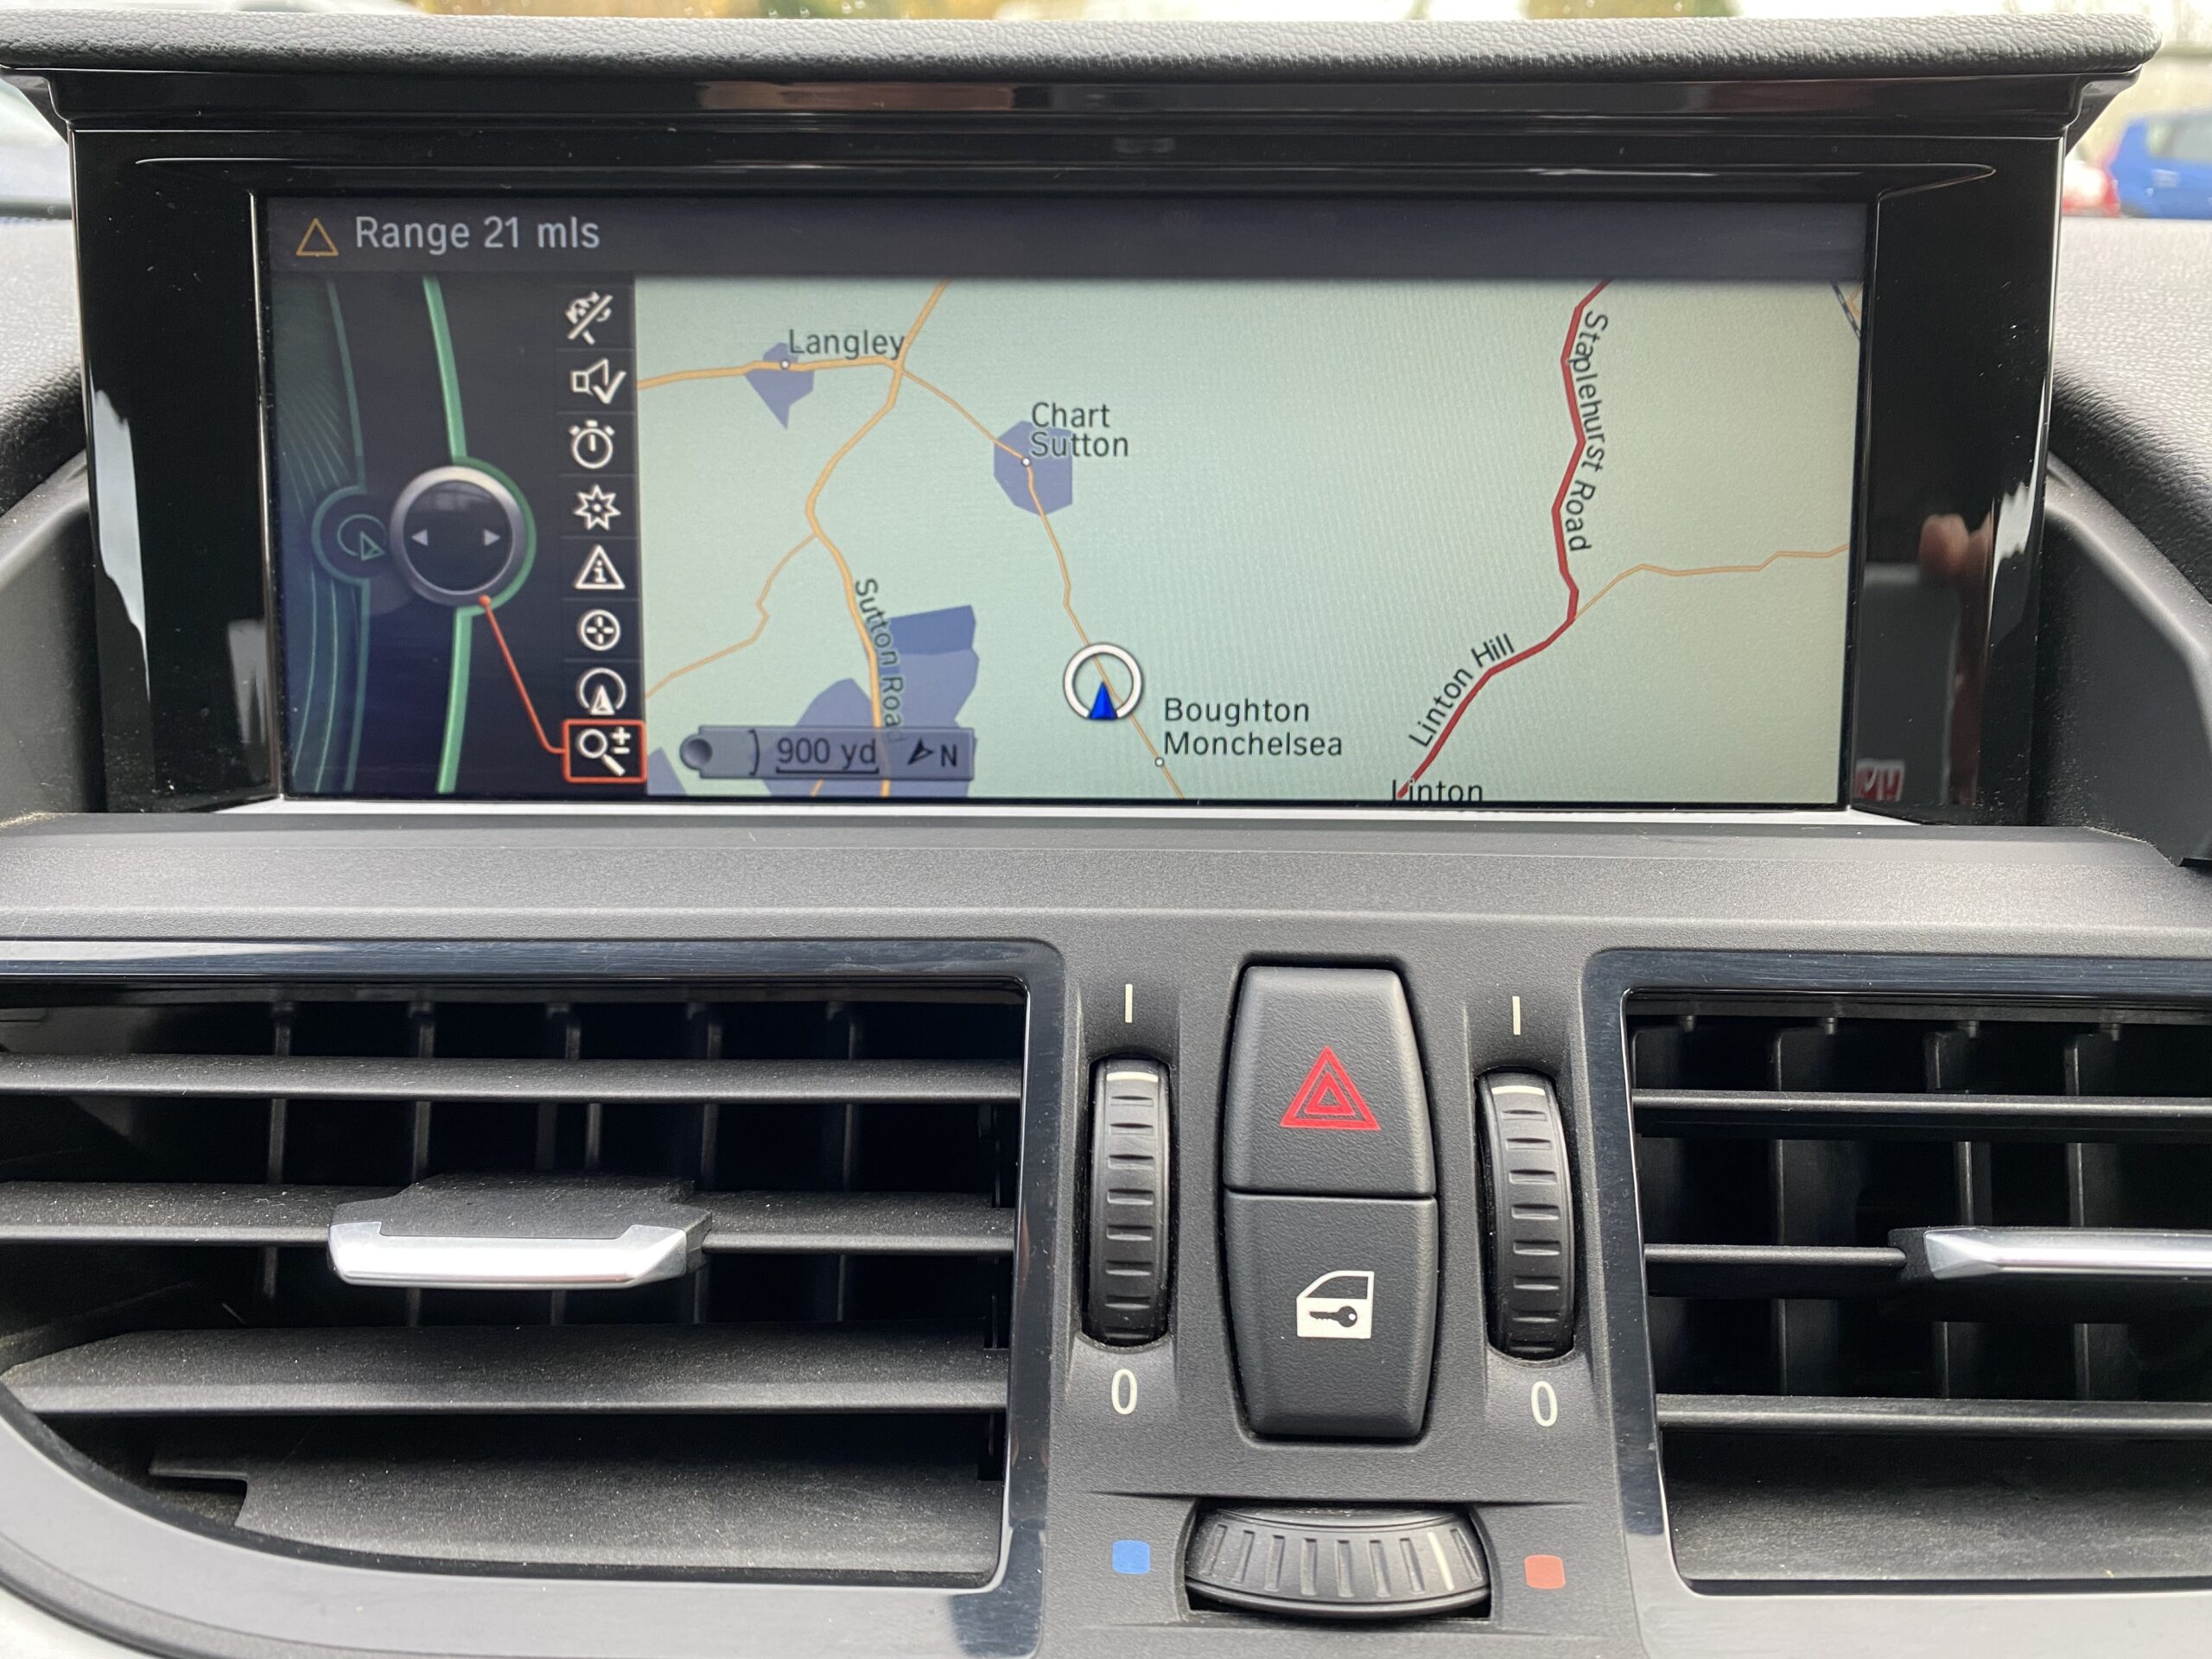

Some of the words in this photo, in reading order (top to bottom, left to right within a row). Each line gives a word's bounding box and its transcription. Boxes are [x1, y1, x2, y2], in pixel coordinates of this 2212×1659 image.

[354, 216, 471, 256] Range
[484, 218, 520, 247] 21
[537, 216, 601, 249] mls
[789, 329, 905, 360] Langley
[1567, 310, 1608, 472] Staplehurst
[1031, 401, 1110, 429] Chart
[1030, 432, 1128, 458] Sutton
[1565, 480, 1596, 551] Road
[855, 579, 899, 667] Sutton
[1408, 666, 1474, 748] Linton
[1470, 633, 1516, 669] Hill
[1164, 697, 1311, 728] Boughton
[777, 737, 831, 764] 900
[842, 738, 876, 771] yd
[941, 744, 958, 766] N
[1164, 731, 1344, 757] Monchelsea
